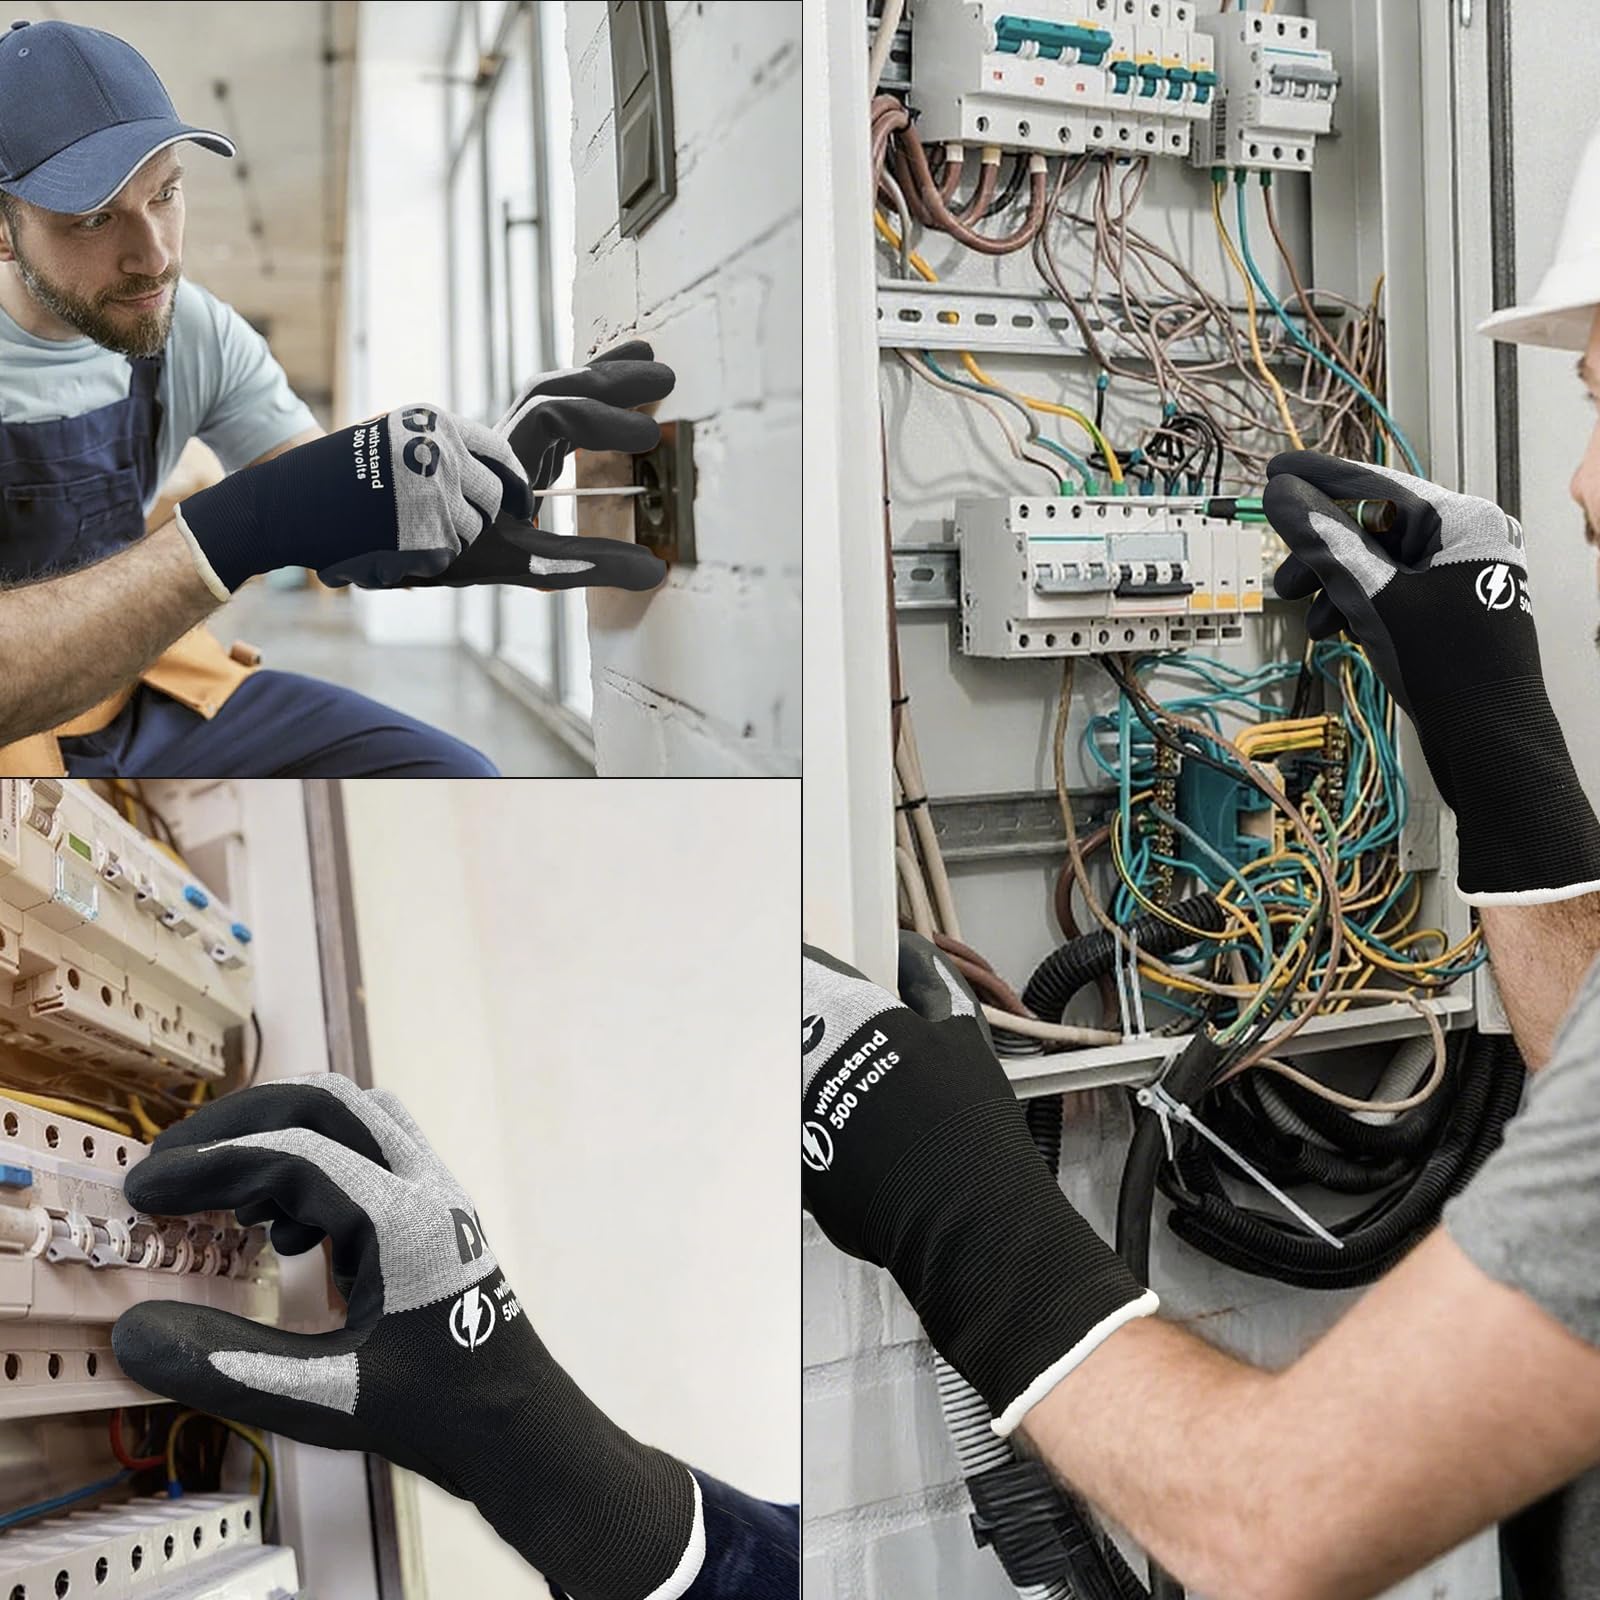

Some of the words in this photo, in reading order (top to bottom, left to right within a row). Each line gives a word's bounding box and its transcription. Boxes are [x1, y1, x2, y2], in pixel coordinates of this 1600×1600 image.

[353, 428, 366, 448] 500
[354, 449, 367, 480] volts
[368, 424, 384, 489] withstand
[813, 1029, 889, 1116] withstand
[829, 1092, 858, 1130] 500
[856, 1050, 900, 1092] volts
